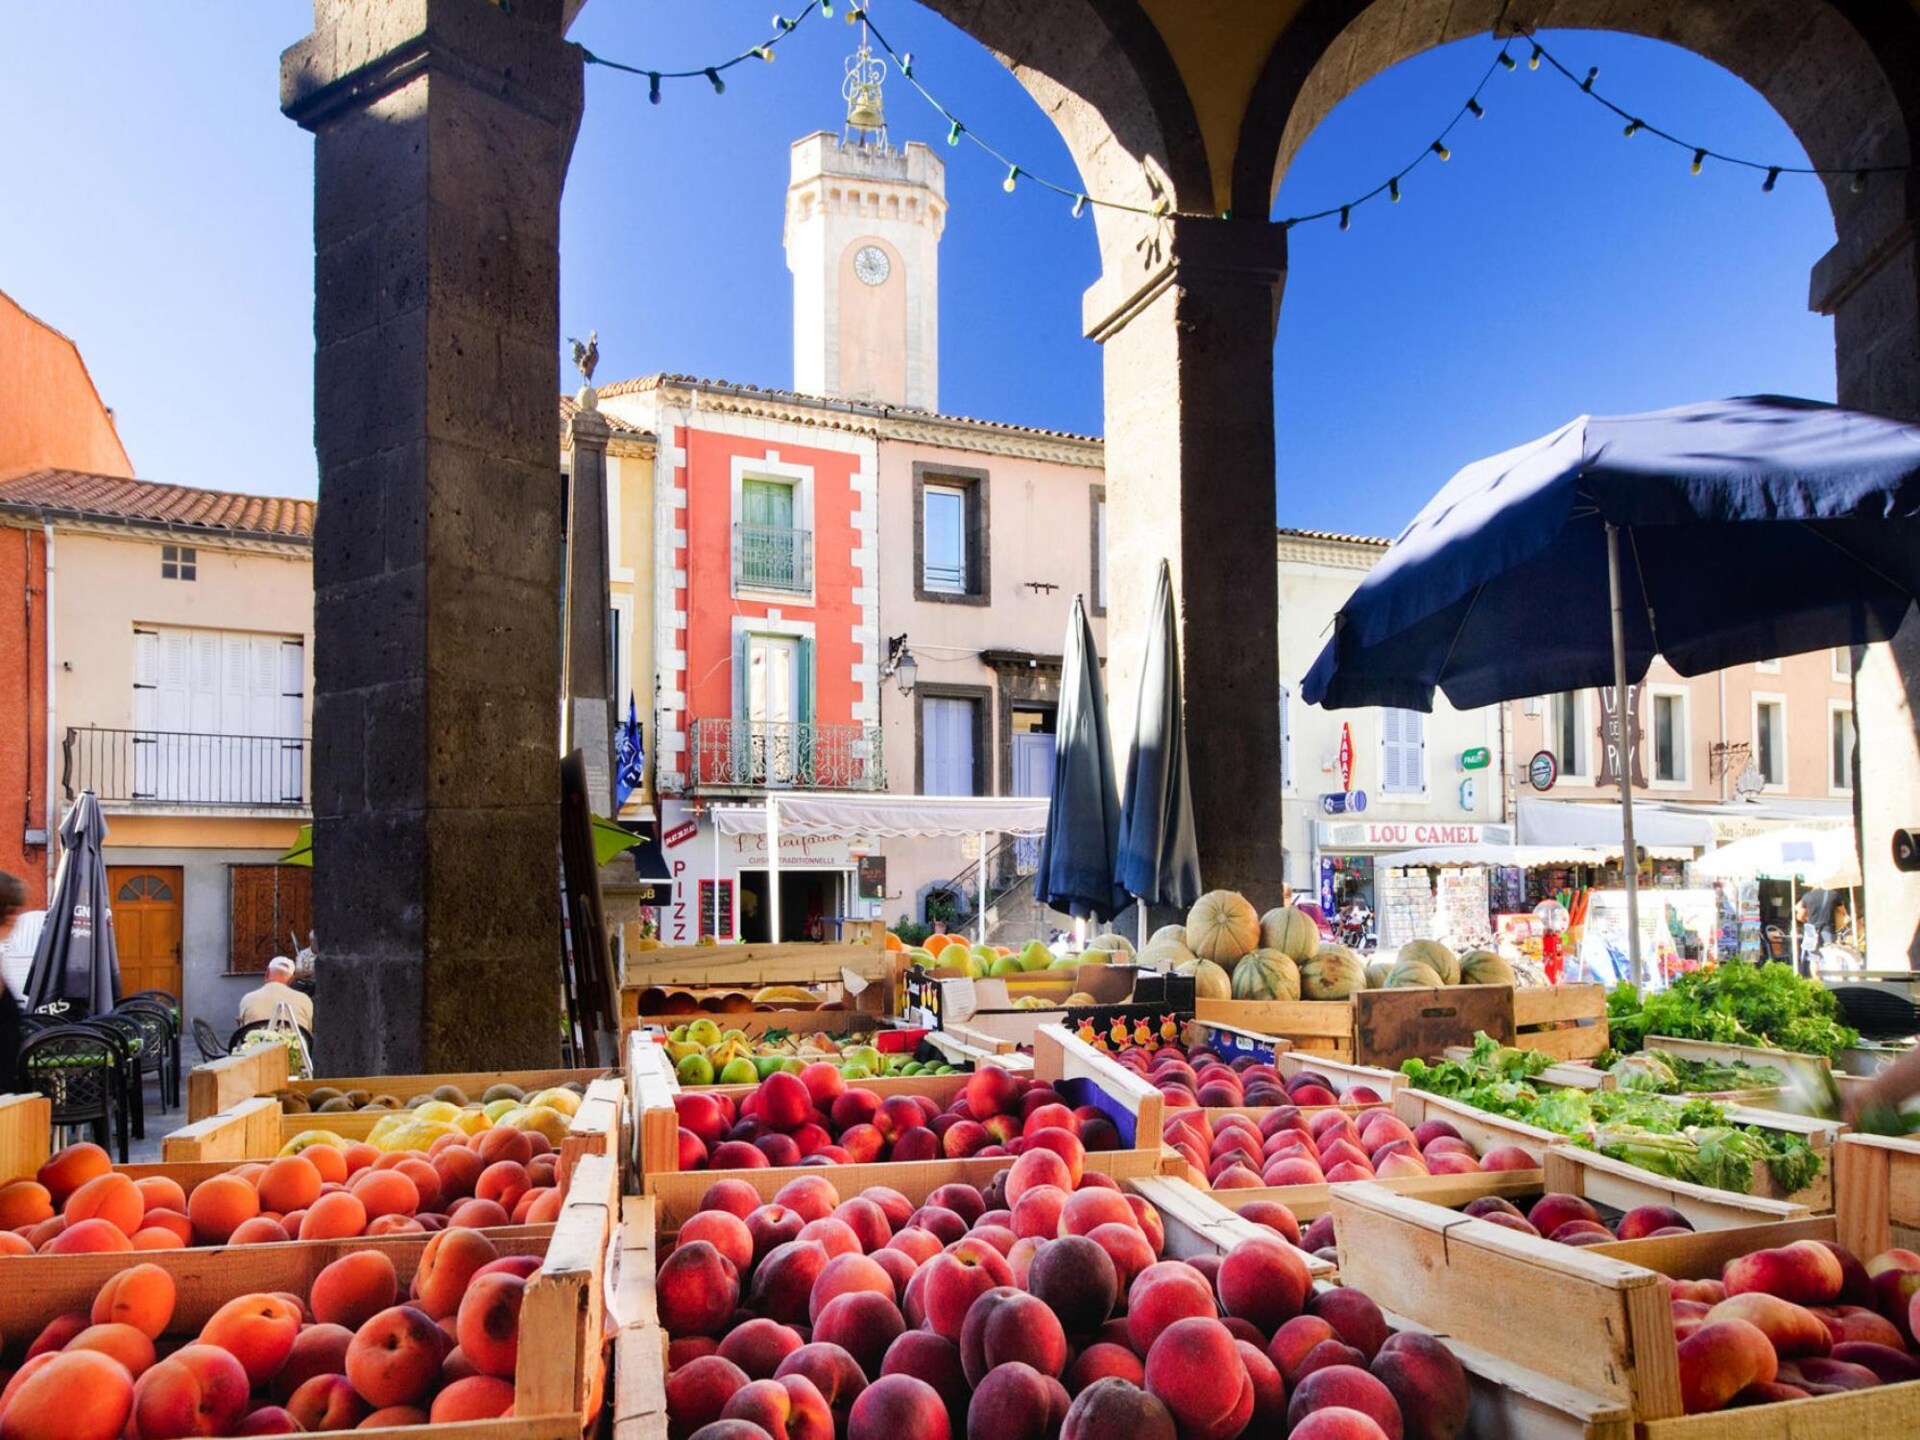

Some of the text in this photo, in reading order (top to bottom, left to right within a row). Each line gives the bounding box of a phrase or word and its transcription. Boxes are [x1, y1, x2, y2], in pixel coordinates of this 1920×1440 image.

[1369, 825, 1478, 844] LOU CAMEL
[778, 857, 835, 865] TRADITIONNELLE
[673, 860, 686, 941] PIZZ
